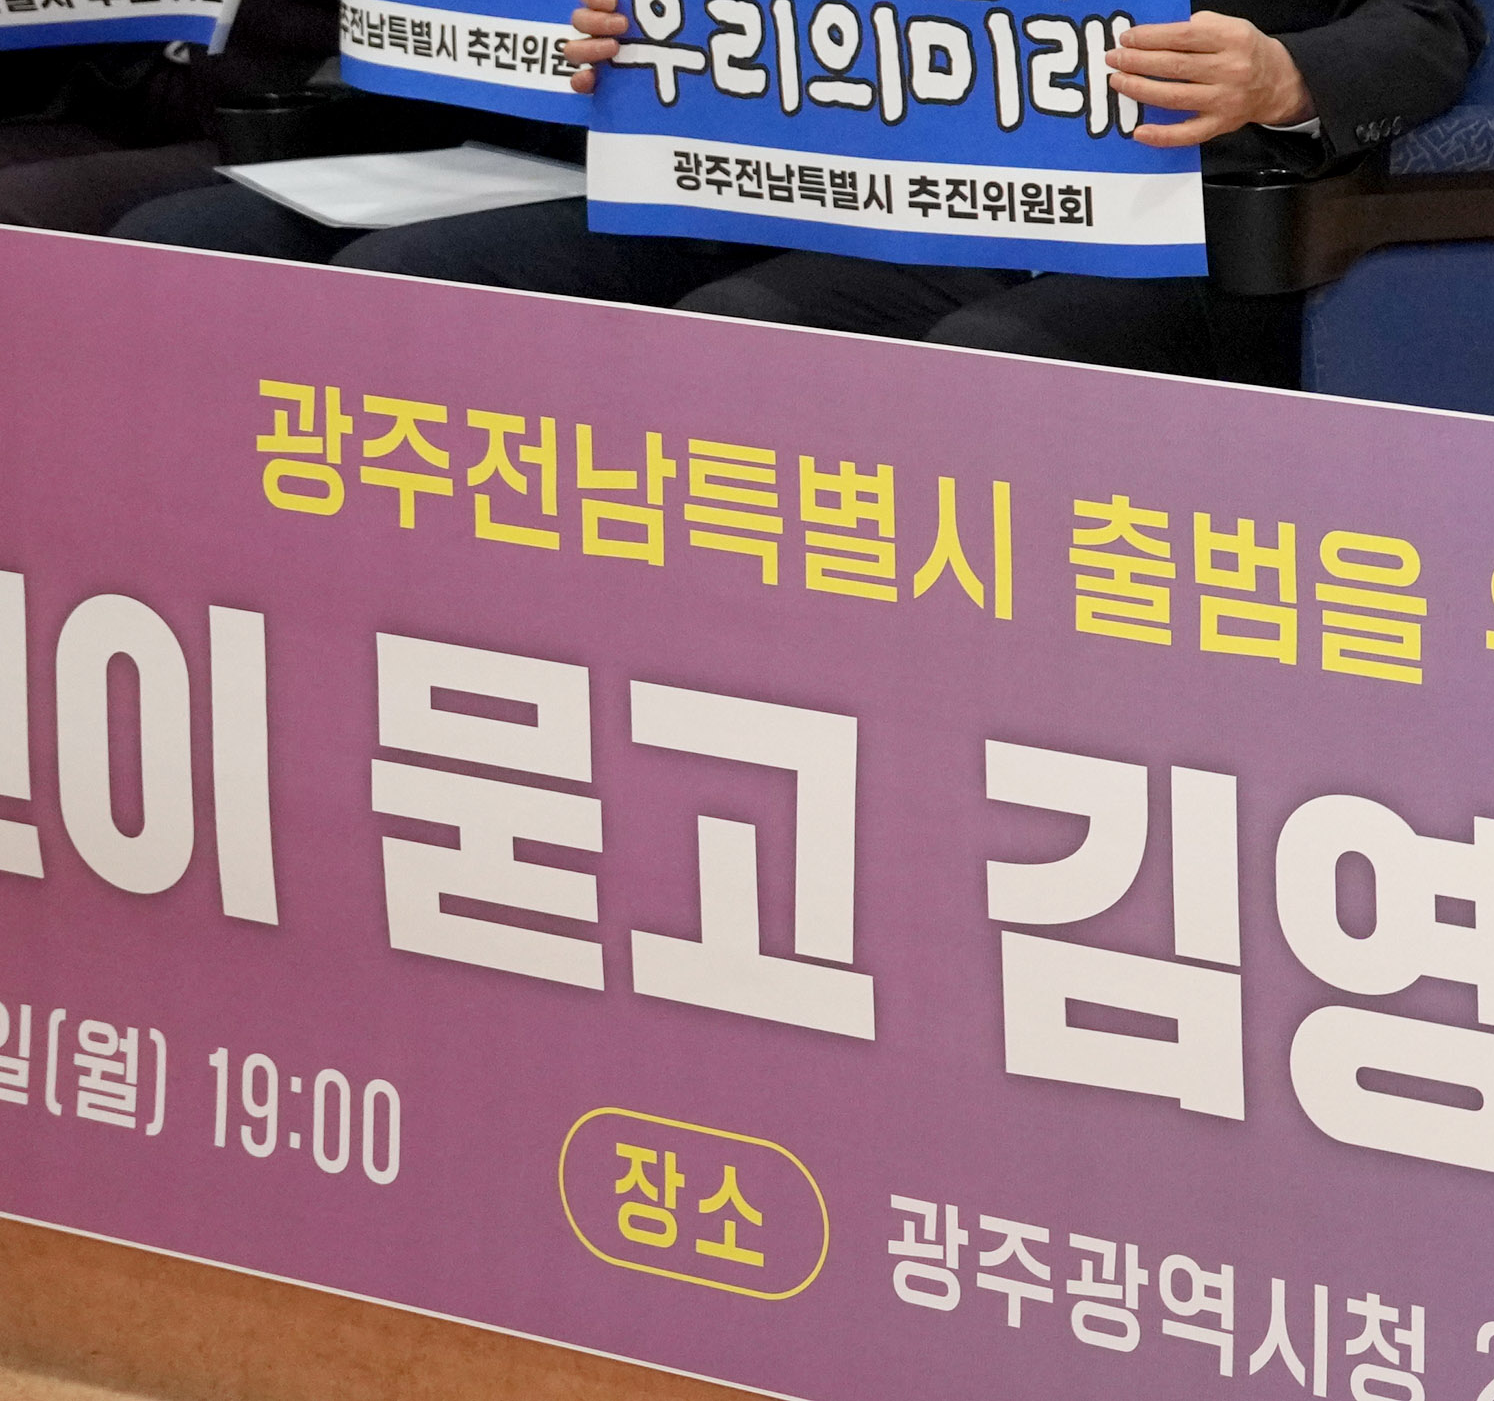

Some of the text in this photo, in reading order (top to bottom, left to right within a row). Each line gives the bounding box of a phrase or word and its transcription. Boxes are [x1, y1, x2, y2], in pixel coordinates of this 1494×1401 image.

[467, 27, 582, 77] 추진위원
[674, 149, 1094, 228] 광주전남특별시 추진위원회
[257, 380, 1012, 619] 광주전남특별시
[1070, 494, 1426, 683] 출범을
[370, 631, 876, 1042] 묻고
[208, 1046, 401, 1186] 19:00
[615, 1142, 766, 1269] 장소
[887, 1193, 1426, 1401] 광주광역시청
